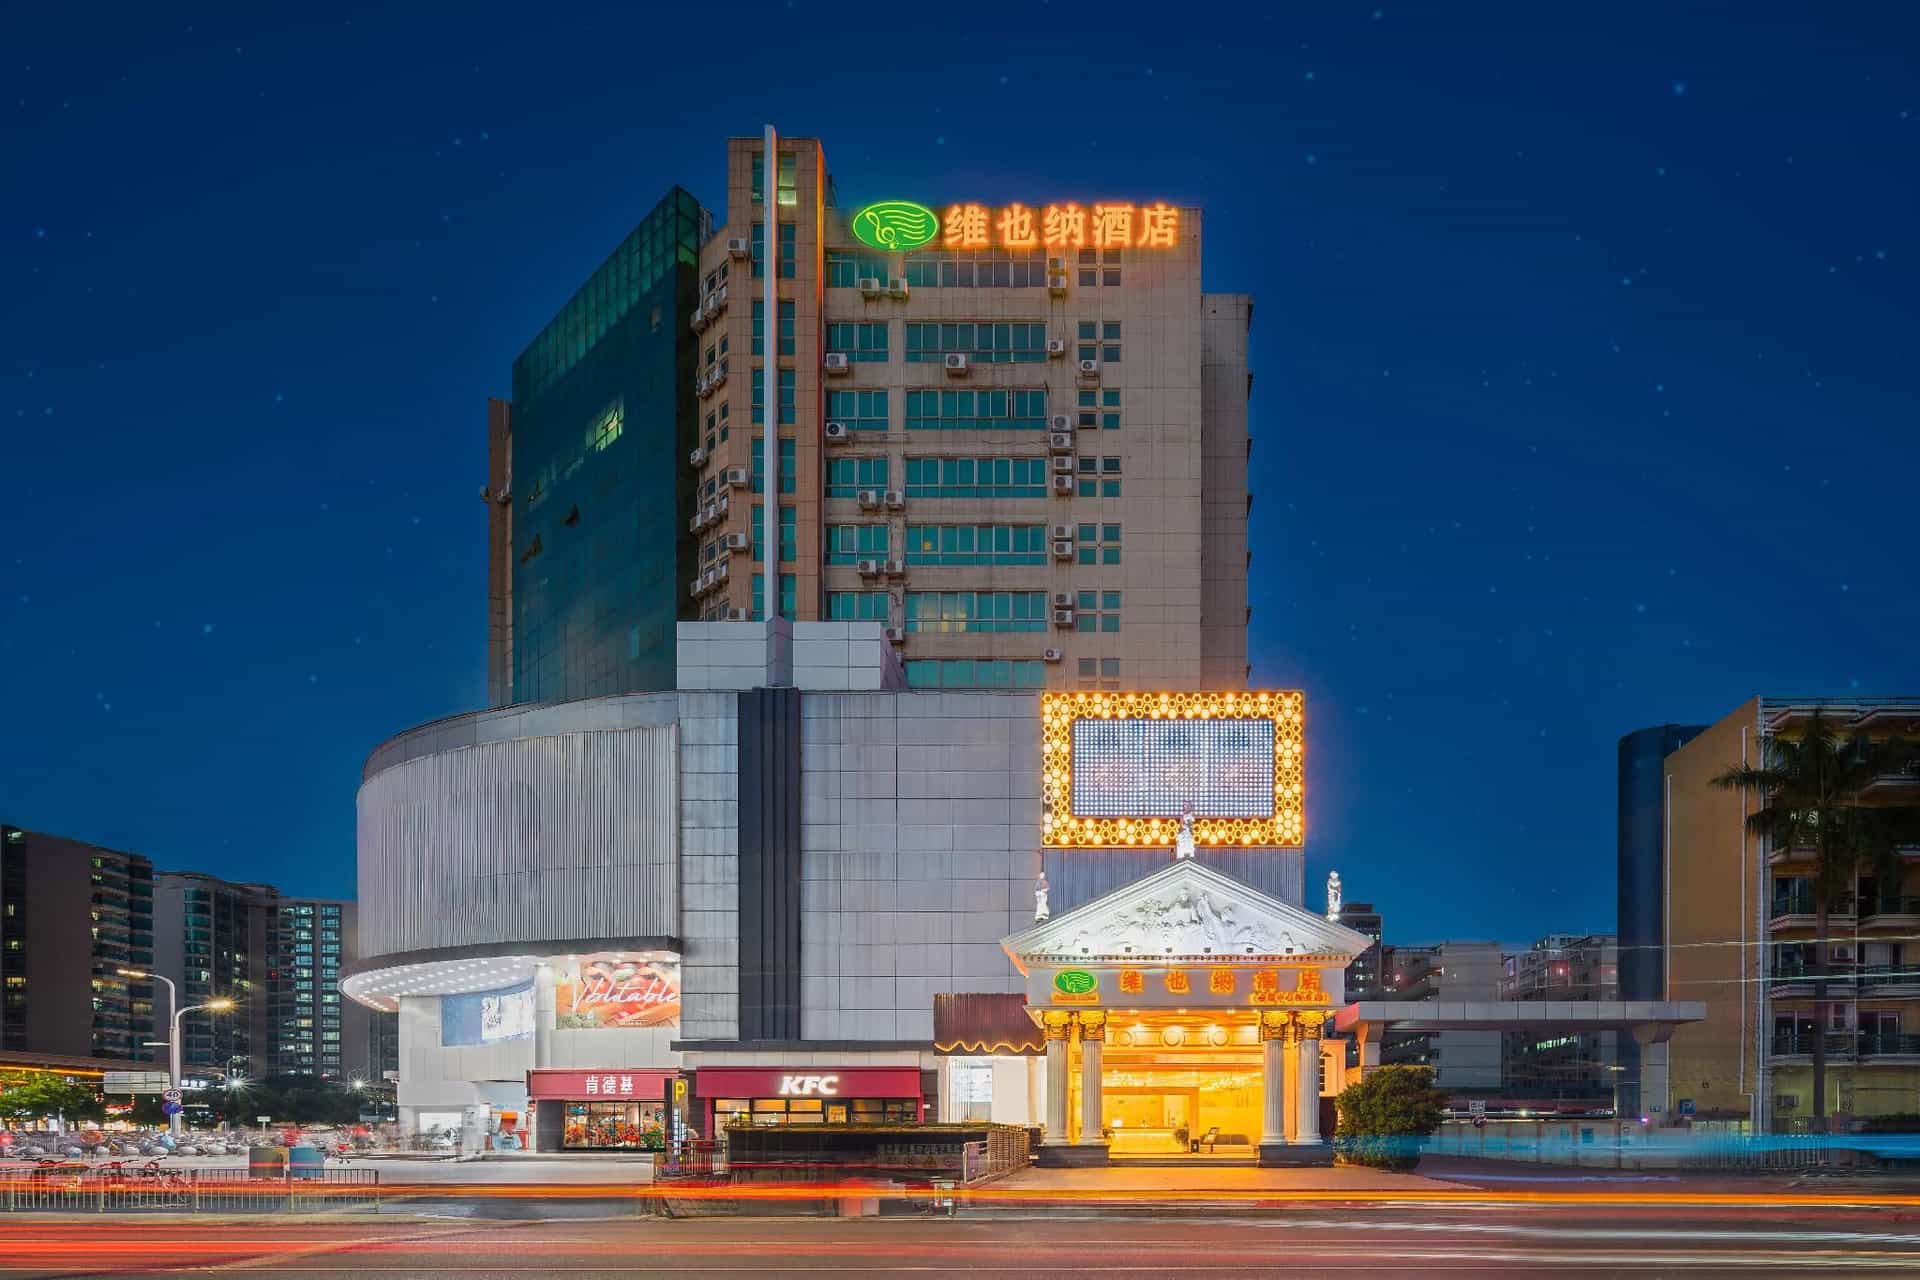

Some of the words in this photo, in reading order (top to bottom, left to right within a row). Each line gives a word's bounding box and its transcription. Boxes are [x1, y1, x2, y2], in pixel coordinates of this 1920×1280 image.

[944, 203, 1178, 248] 维也纳酒店
[1119, 969, 1321, 993] 维也纳酒店
[166, 1091, 179, 1099] 40
[585, 1074, 633, 1095] 肯德基
[674, 1080, 687, 1104] P
[779, 1075, 838, 1095] KFC
